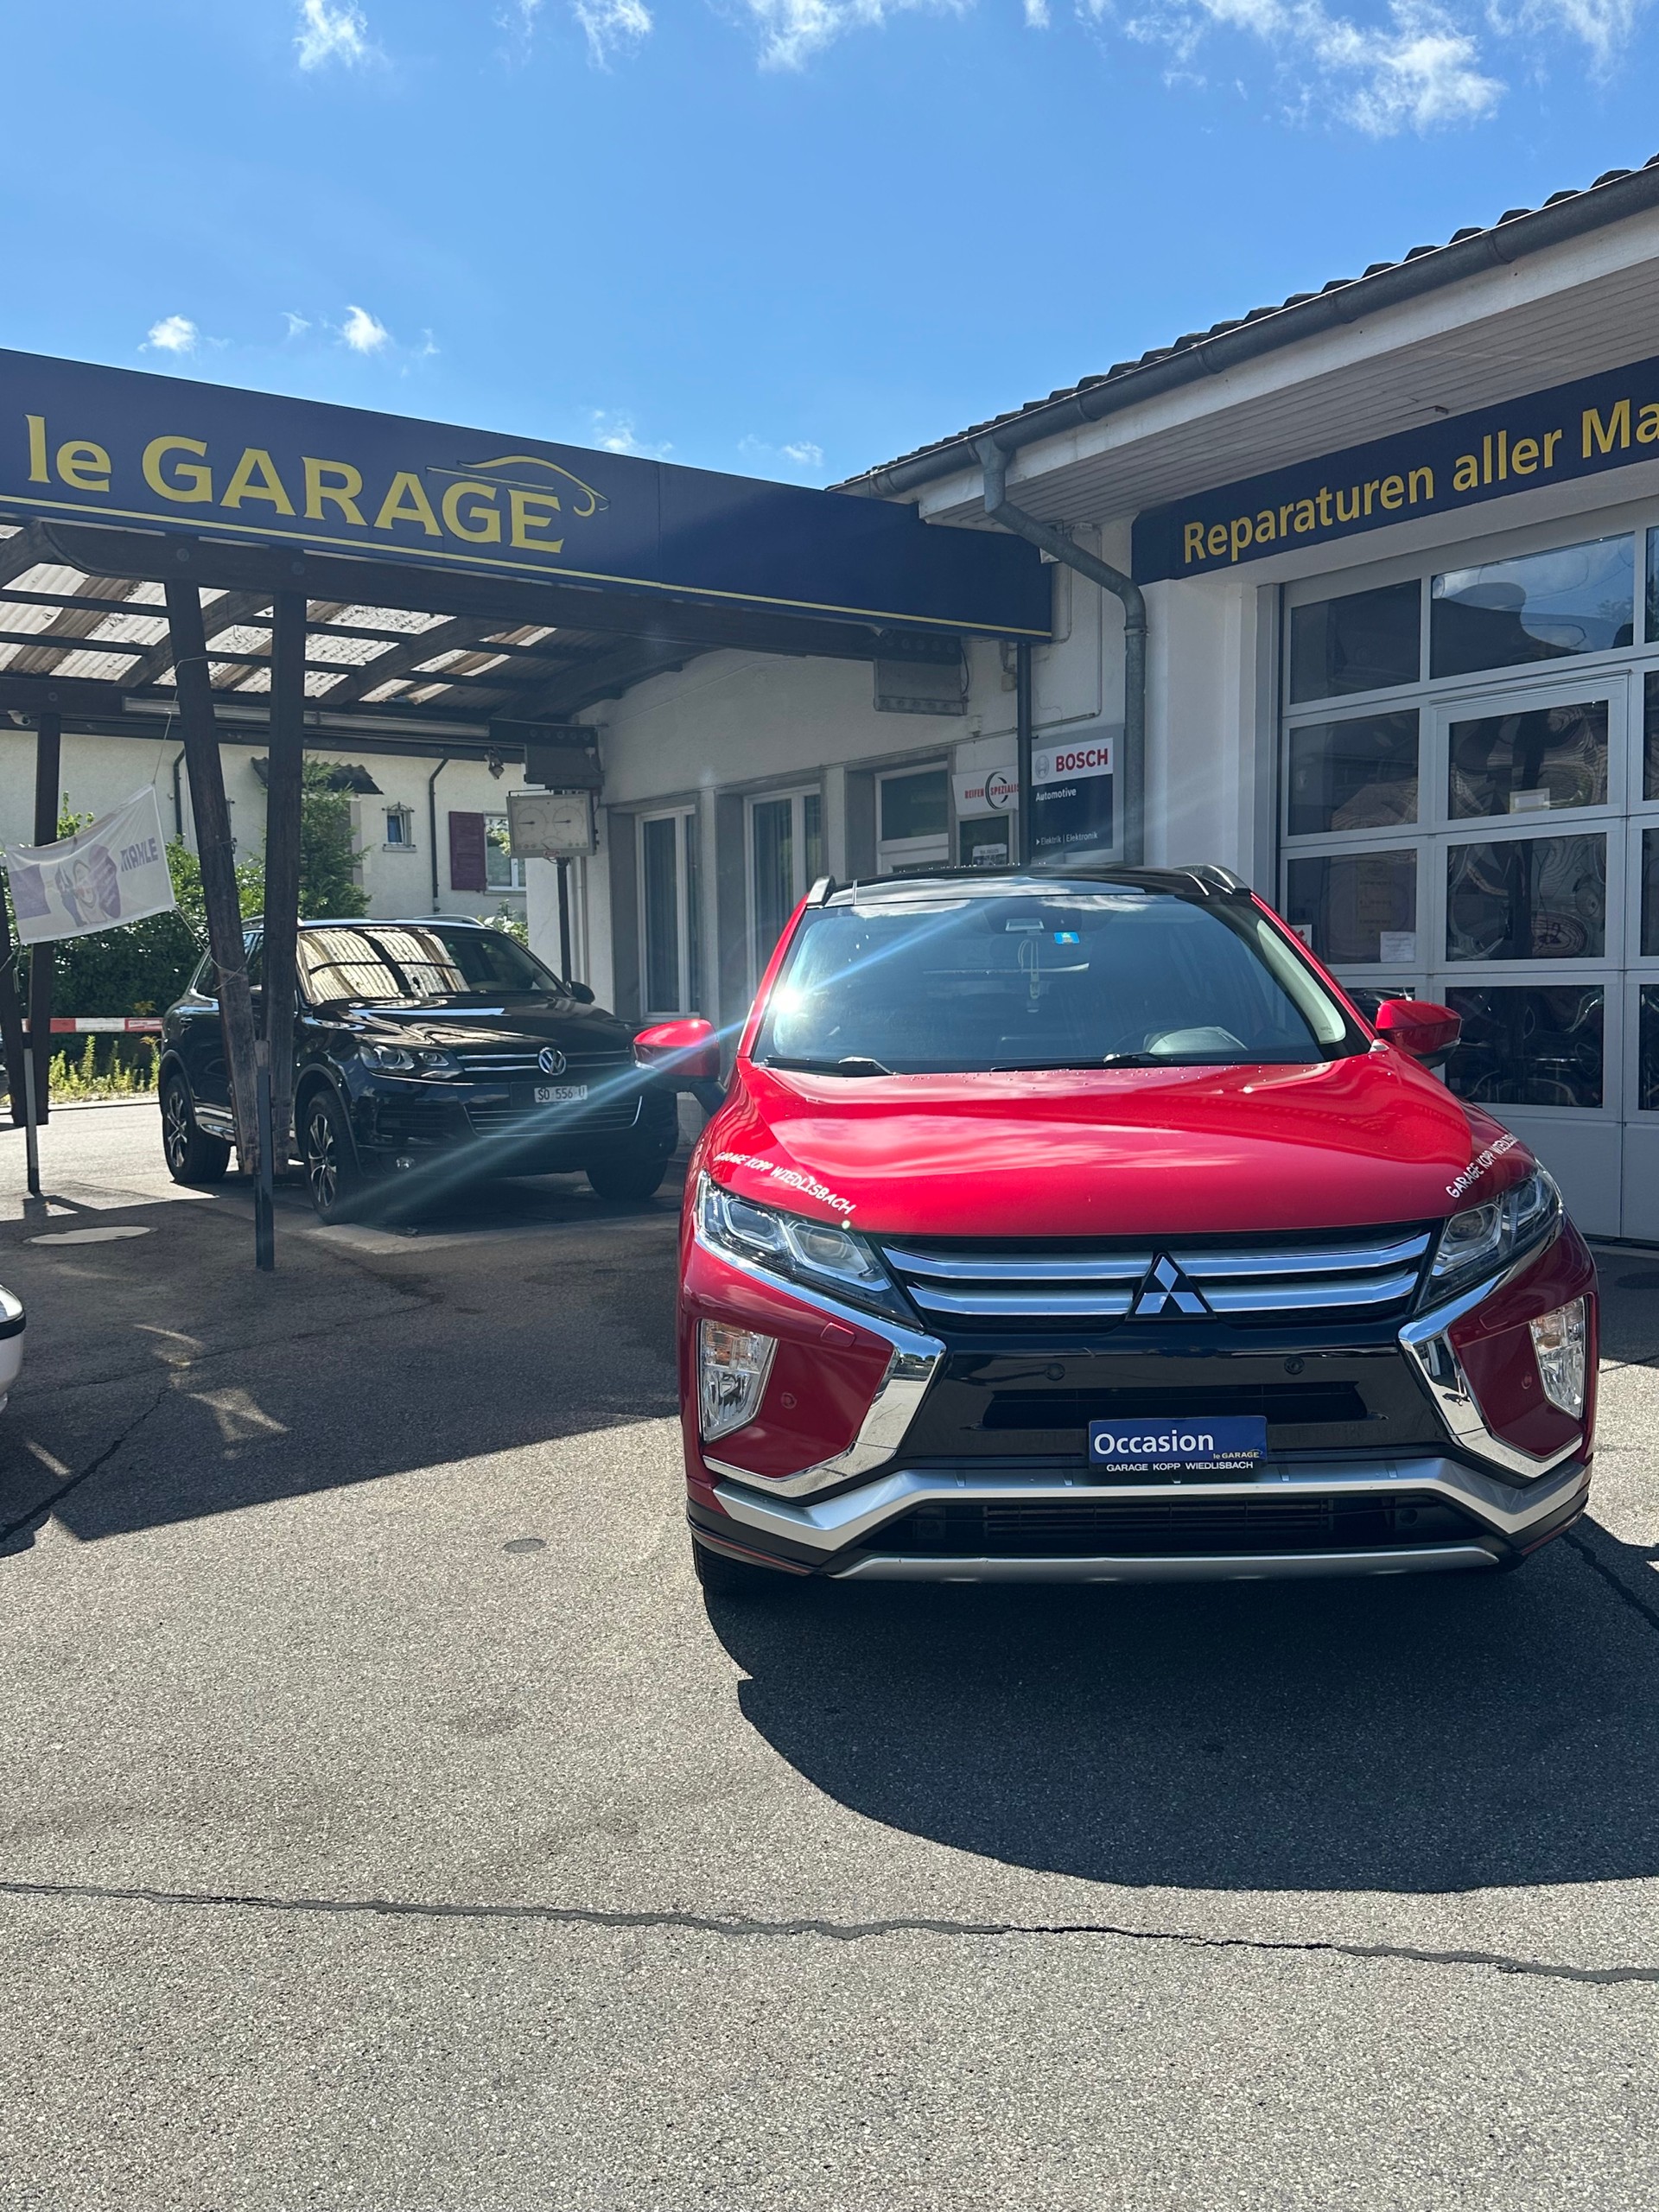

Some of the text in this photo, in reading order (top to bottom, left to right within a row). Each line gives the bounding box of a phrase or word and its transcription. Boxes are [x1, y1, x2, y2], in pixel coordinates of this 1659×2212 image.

[23, 414, 564, 554] le GARAGE
[1183, 398, 1659, 565] Reparaturen aller Ma
[1056, 747, 1109, 772] BOSCH
[1035, 787, 1077, 803] Automotive
[1040, 831, 1098, 846] Elektrik Elektronik
[120, 837, 158, 872] MAHLE
[556, 1087, 574, 1100] 556
[713, 1151, 857, 1215] GARAGE KOPP WIEDLISBACH
[1446, 1162, 1484, 1198] GARAGE
[1476, 1150, 1497, 1170] KOPP
[1094, 1429, 1214, 1455] Occasion
[1106, 1461, 1254, 1472] GARAGE KOPP WIEDLISBACH
[1222, 1451, 1260, 1459] GARAGE
